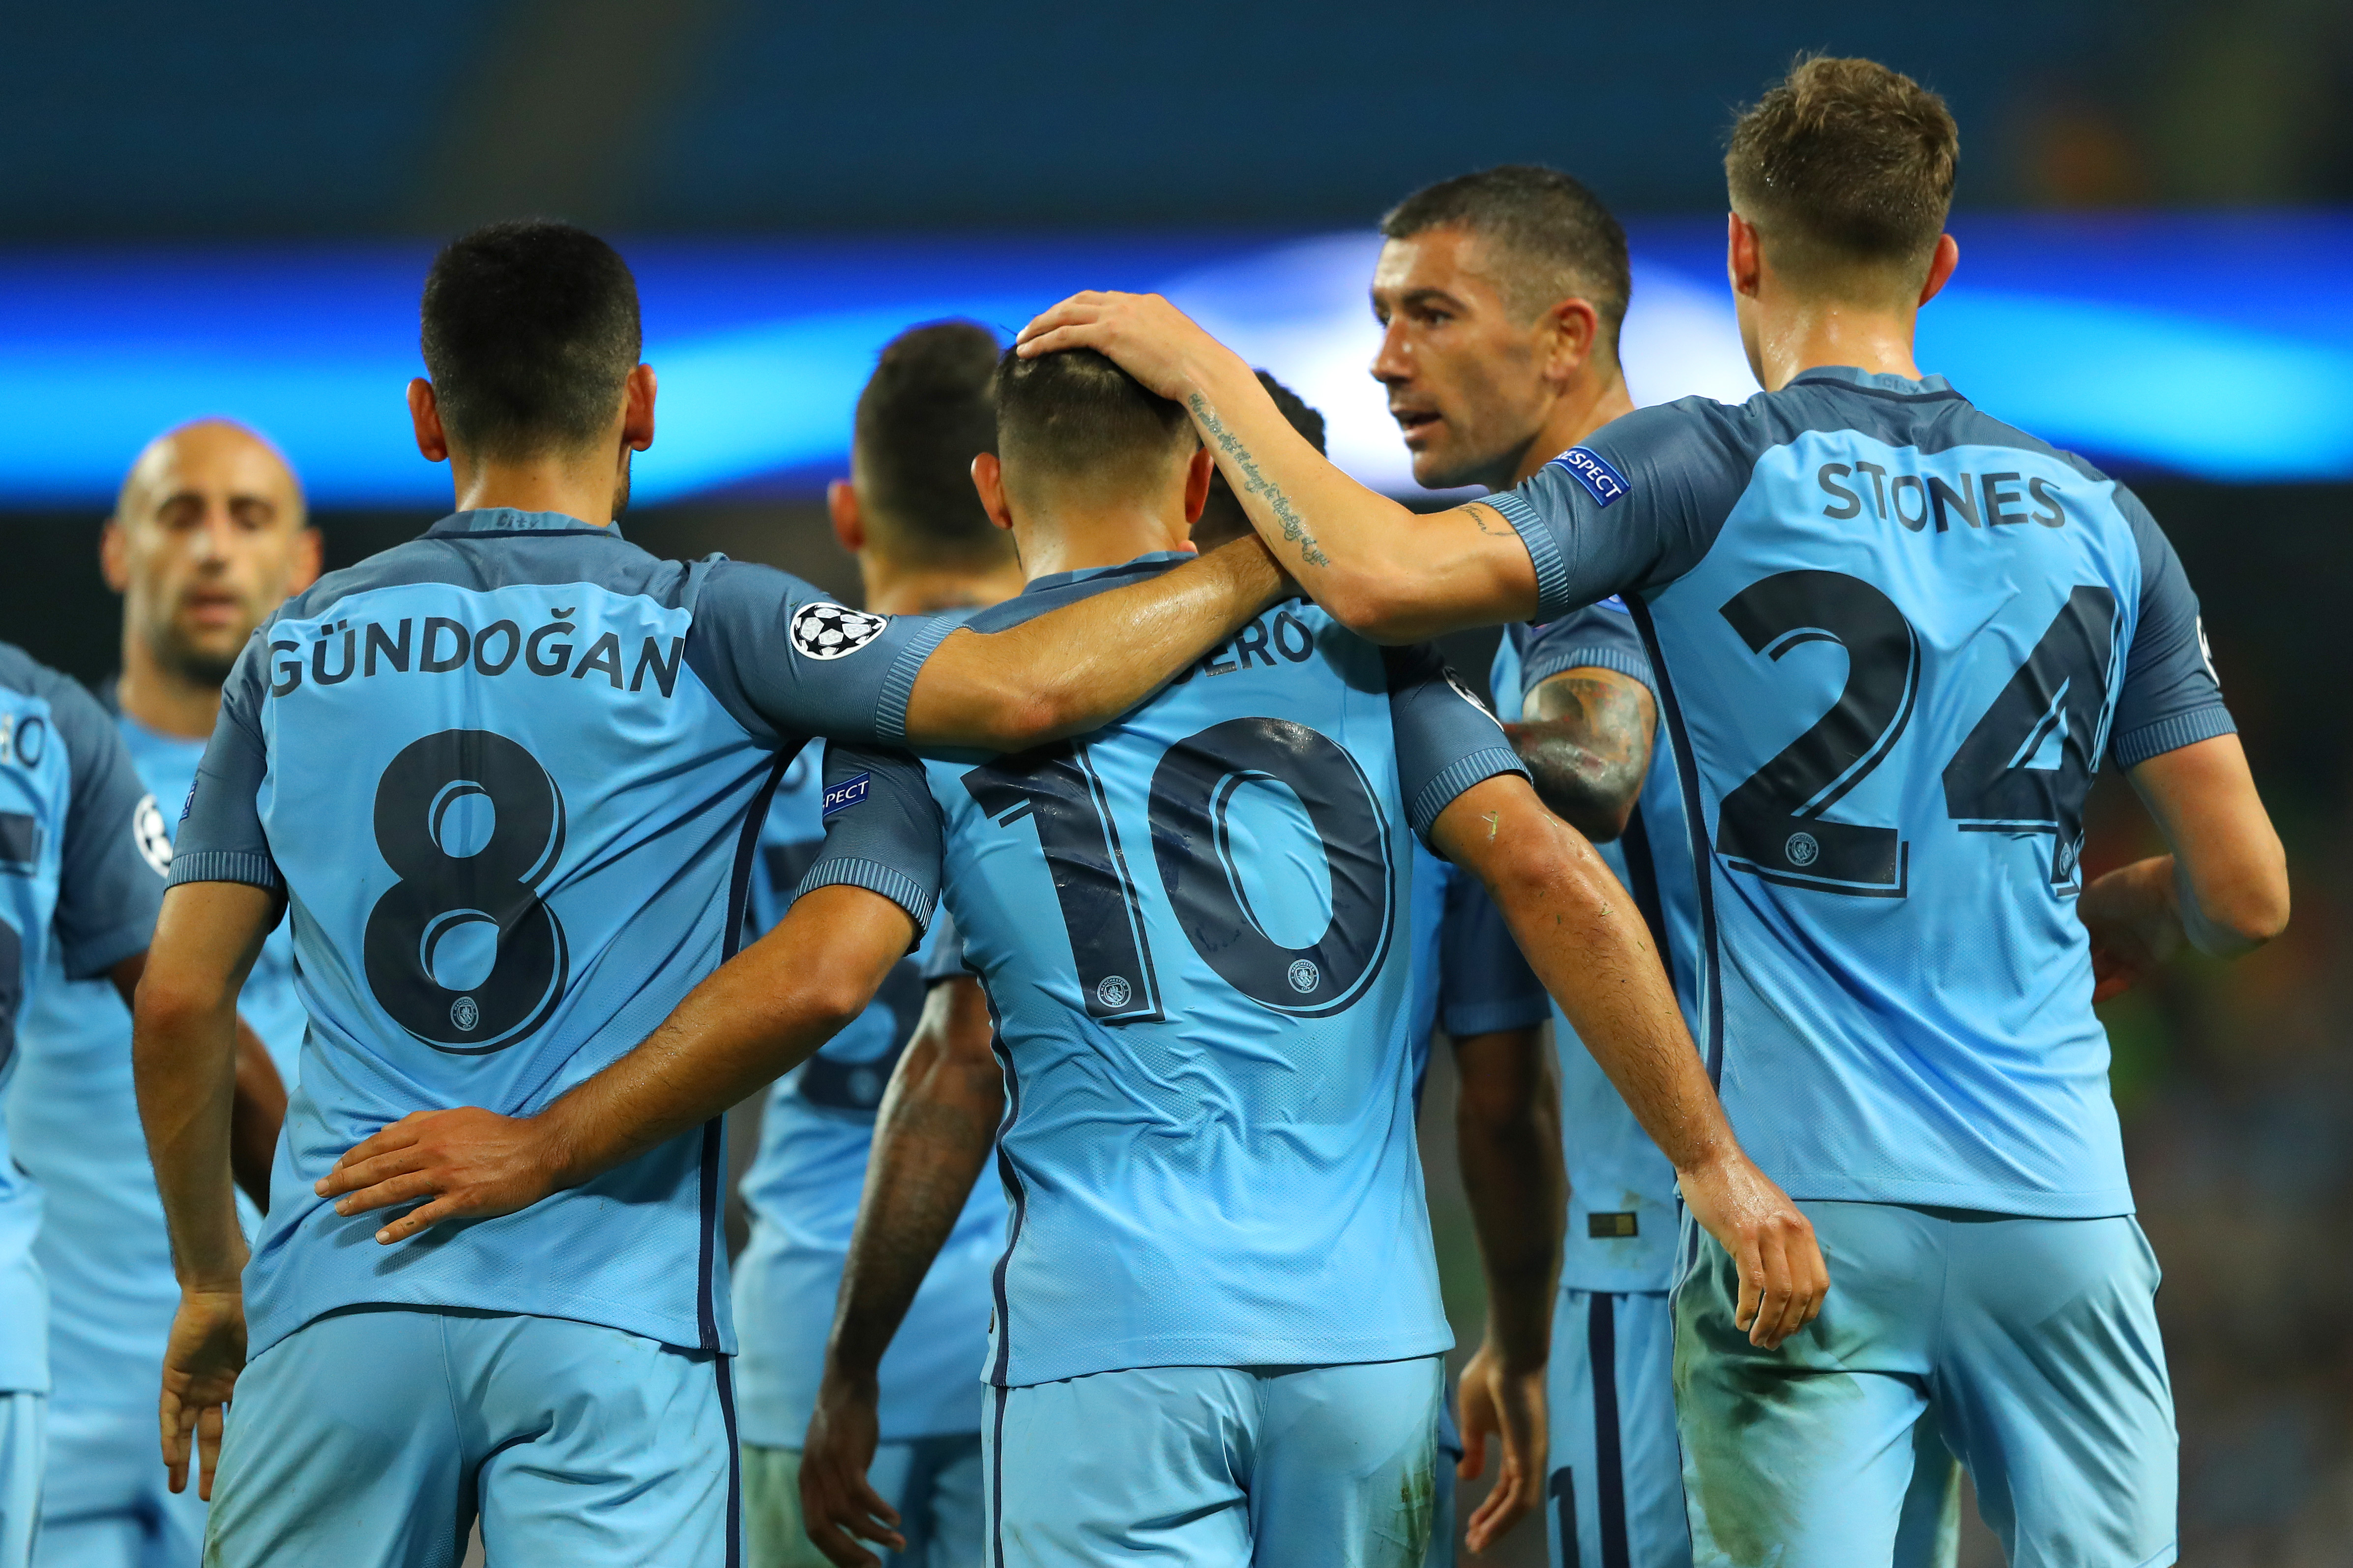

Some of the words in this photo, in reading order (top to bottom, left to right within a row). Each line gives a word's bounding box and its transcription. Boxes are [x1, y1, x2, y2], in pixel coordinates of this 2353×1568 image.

[1818, 461, 2065, 533] STONES
[268, 607, 685, 698] GÜNDOĞAN
[1716, 570, 2123, 899] 24
[364, 728, 569, 1056] 8
[960, 717, 1395, 1022] 10
[1101, 979, 1126, 991] MANCHESTER
[1292, 962, 1315, 973] MANCHESTER
